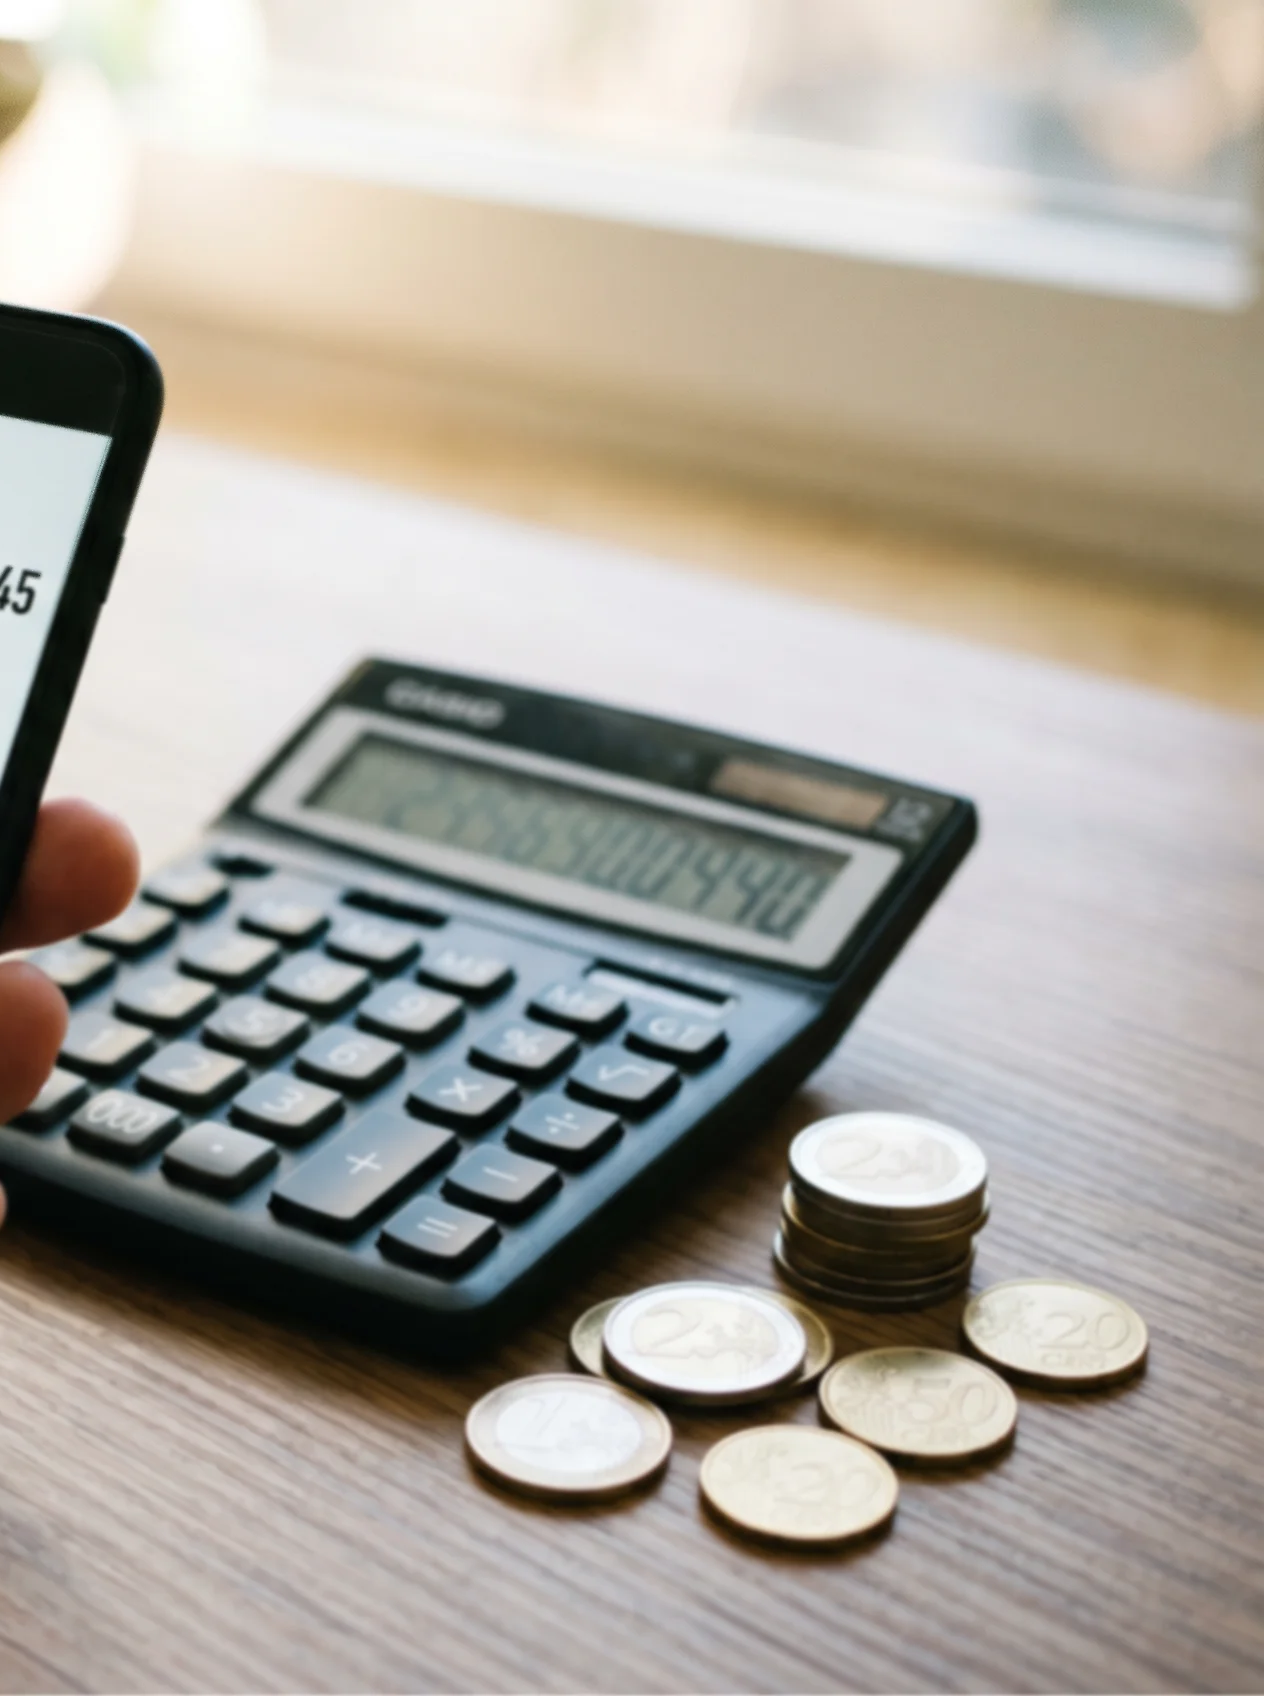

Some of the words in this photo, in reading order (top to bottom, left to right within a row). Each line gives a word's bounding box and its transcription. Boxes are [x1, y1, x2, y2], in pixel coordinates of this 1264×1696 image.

[167, 1055, 213, 1083] 2
[260, 1085, 307, 1115] 3
[1038, 1309, 1132, 1352] 20
